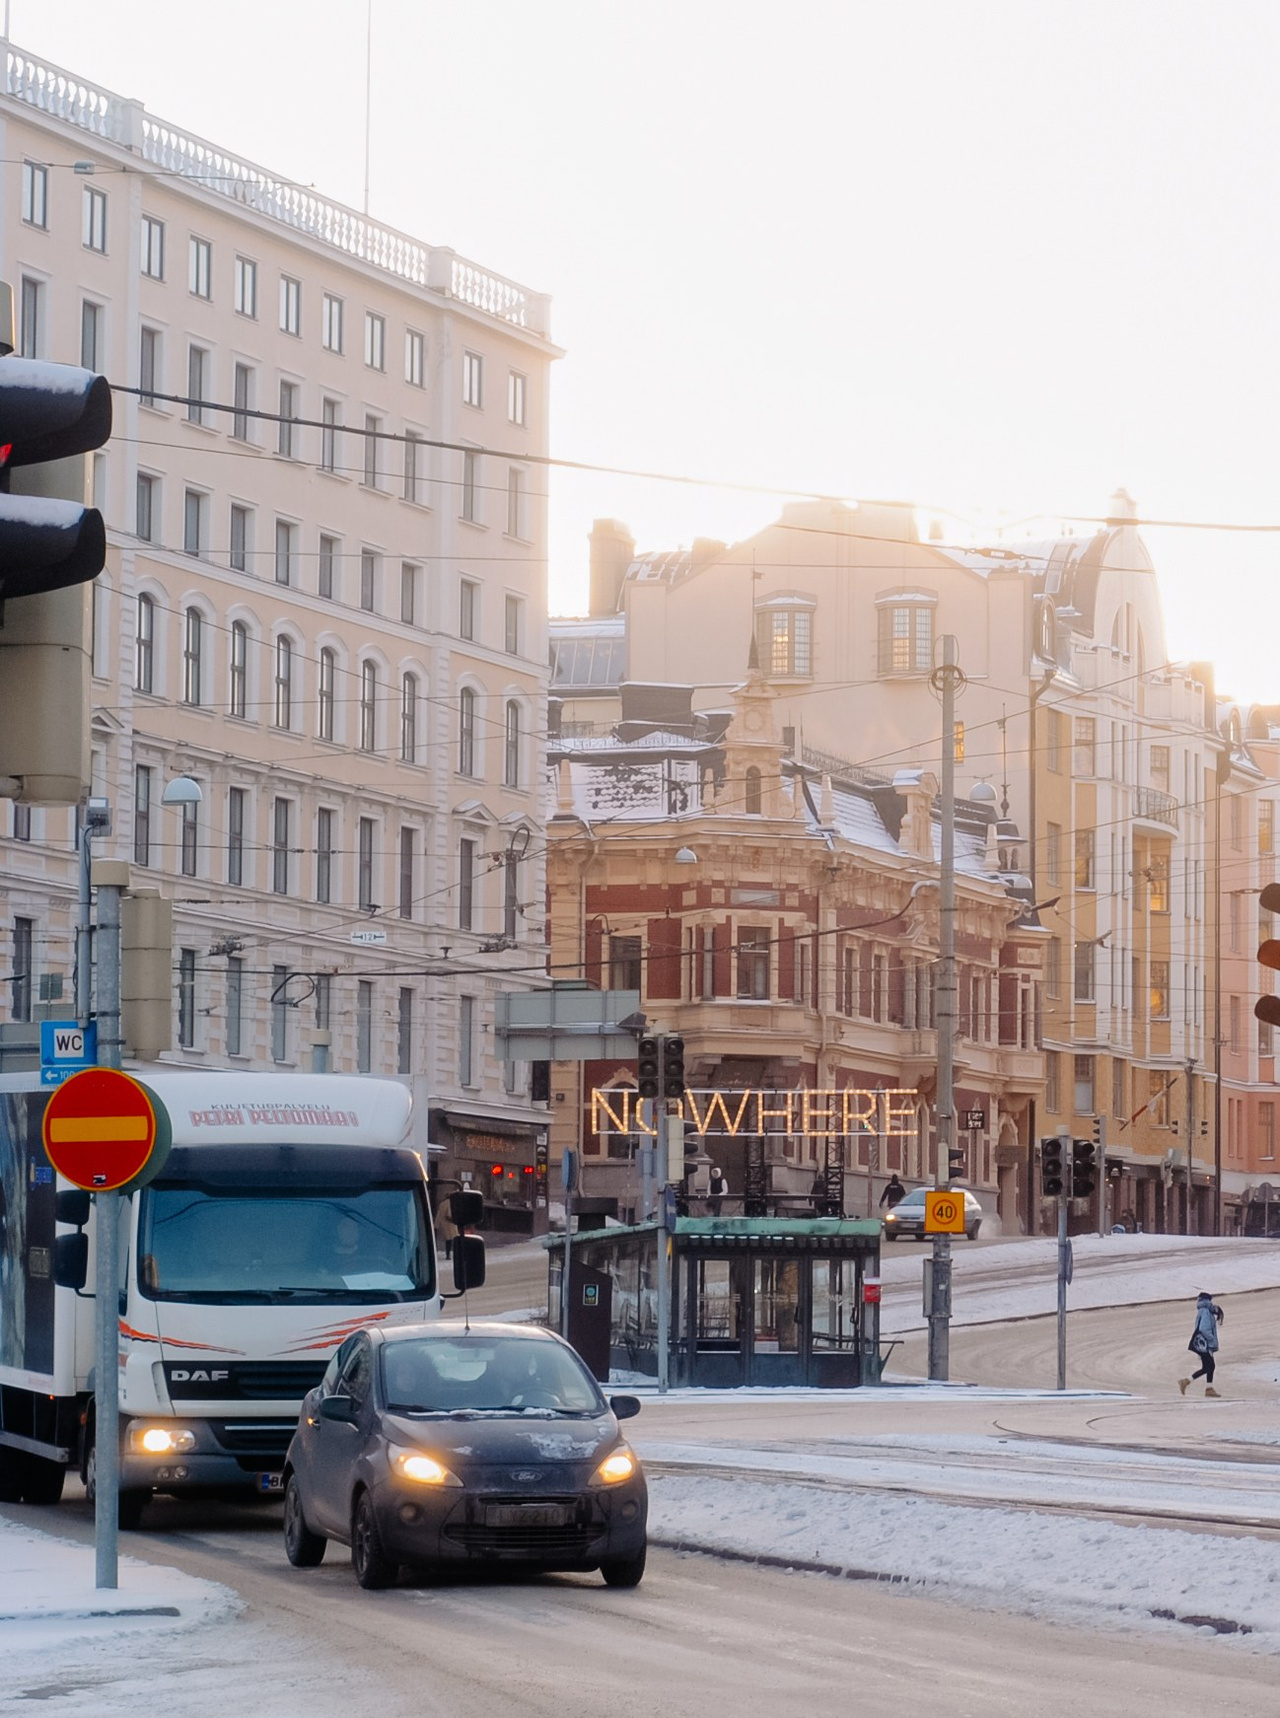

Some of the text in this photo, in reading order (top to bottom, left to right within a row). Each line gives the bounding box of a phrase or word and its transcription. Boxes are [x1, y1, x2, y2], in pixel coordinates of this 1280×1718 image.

[56, 1034, 83, 1051] WC
[936, 1205, 954, 1219] 40
[171, 1370, 229, 1382] DAF
[518, 1470, 536, 1480] Ford
